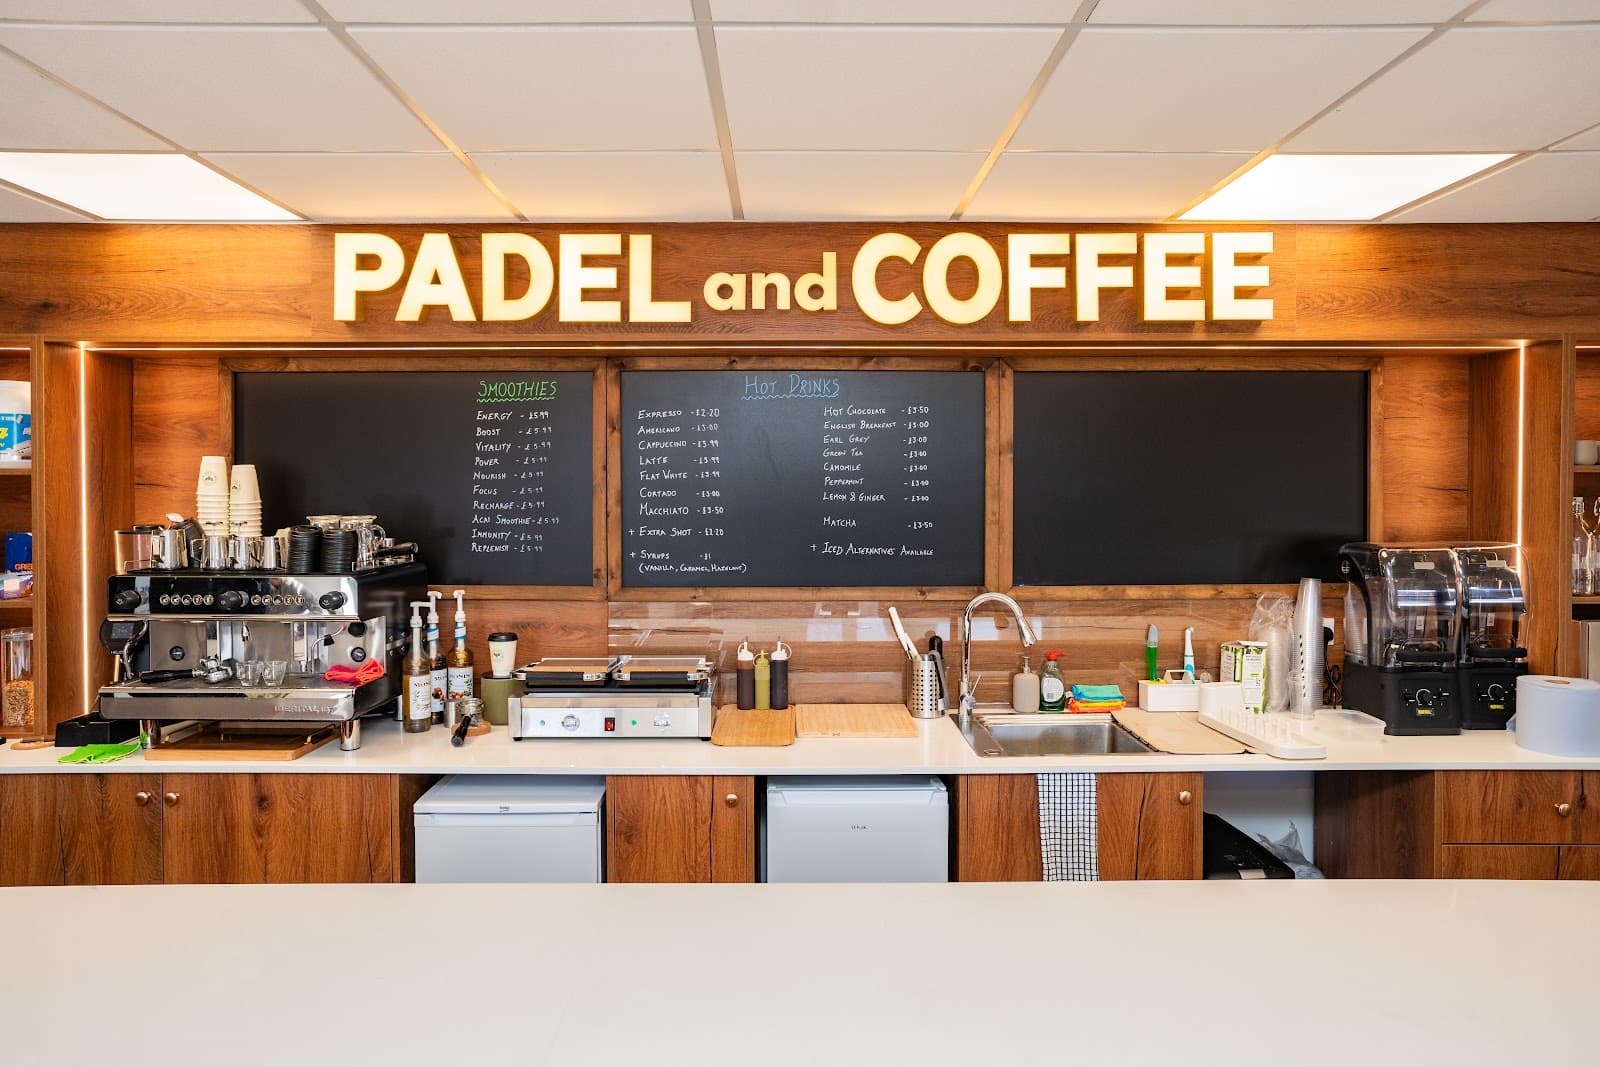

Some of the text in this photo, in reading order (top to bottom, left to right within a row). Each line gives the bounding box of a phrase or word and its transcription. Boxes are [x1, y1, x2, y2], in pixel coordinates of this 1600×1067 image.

[334, 232, 1274, 324] PADEL and COFFEE
[478, 380, 558, 397] SMOOTHIES
[744, 373, 840, 396] HOT DRINKS
[476, 410, 512, 421] ENERGY
[637, 409, 682, 420] EXPRESSO
[823, 406, 844, 416] HOT
[846, 404, 886, 416] CHOCOLATE
[824, 420, 856, 430] ENGLISH
[860, 419, 897, 430] BREAKFAST
[476, 426, 500, 436] BOOST
[636, 425, 680, 436] AMERICANO
[823, 434, 844, 444] EARL
[848, 434, 870, 444] GREY
[475, 441, 512, 453] VITALITY
[638, 440, 688, 450] CAPPUCCINO
[822, 447, 846, 458] GREEN
[850, 446, 864, 457] TEA
[474, 456, 500, 466] POWER
[640, 456, 669, 466] LATTE
[823, 462, 862, 472] CAMOMILE
[472, 471, 506, 480] NOURISH
[640, 470, 660, 480] FLAT
[662, 469, 688, 480] WHITE
[824, 476, 865, 486] PEPPERMINT
[472, 484, 498, 496] FOCUS
[640, 487, 678, 498] CORTADO
[822, 491, 848, 502] LEMON
[858, 492, 886, 502] GINGER
[472, 500, 515, 510] RECHARGE
[640, 502, 690, 516] MACCHIATO
[495, 514, 532, 525] SMOOTHIE
[823, 516, 857, 528] MATCHA
[472, 528, 512, 542] IMMUNITY
[640, 526, 667, 536] EXTRA
[670, 527, 692, 537] SHOT
[471, 542, 510, 553] REPLENISH
[821, 541, 844, 556] ICED
[845, 542, 896, 556] ALTERNATIVES
[900, 544, 934, 556] AVAILABLE
[640, 550, 670, 560] SYRUPS
